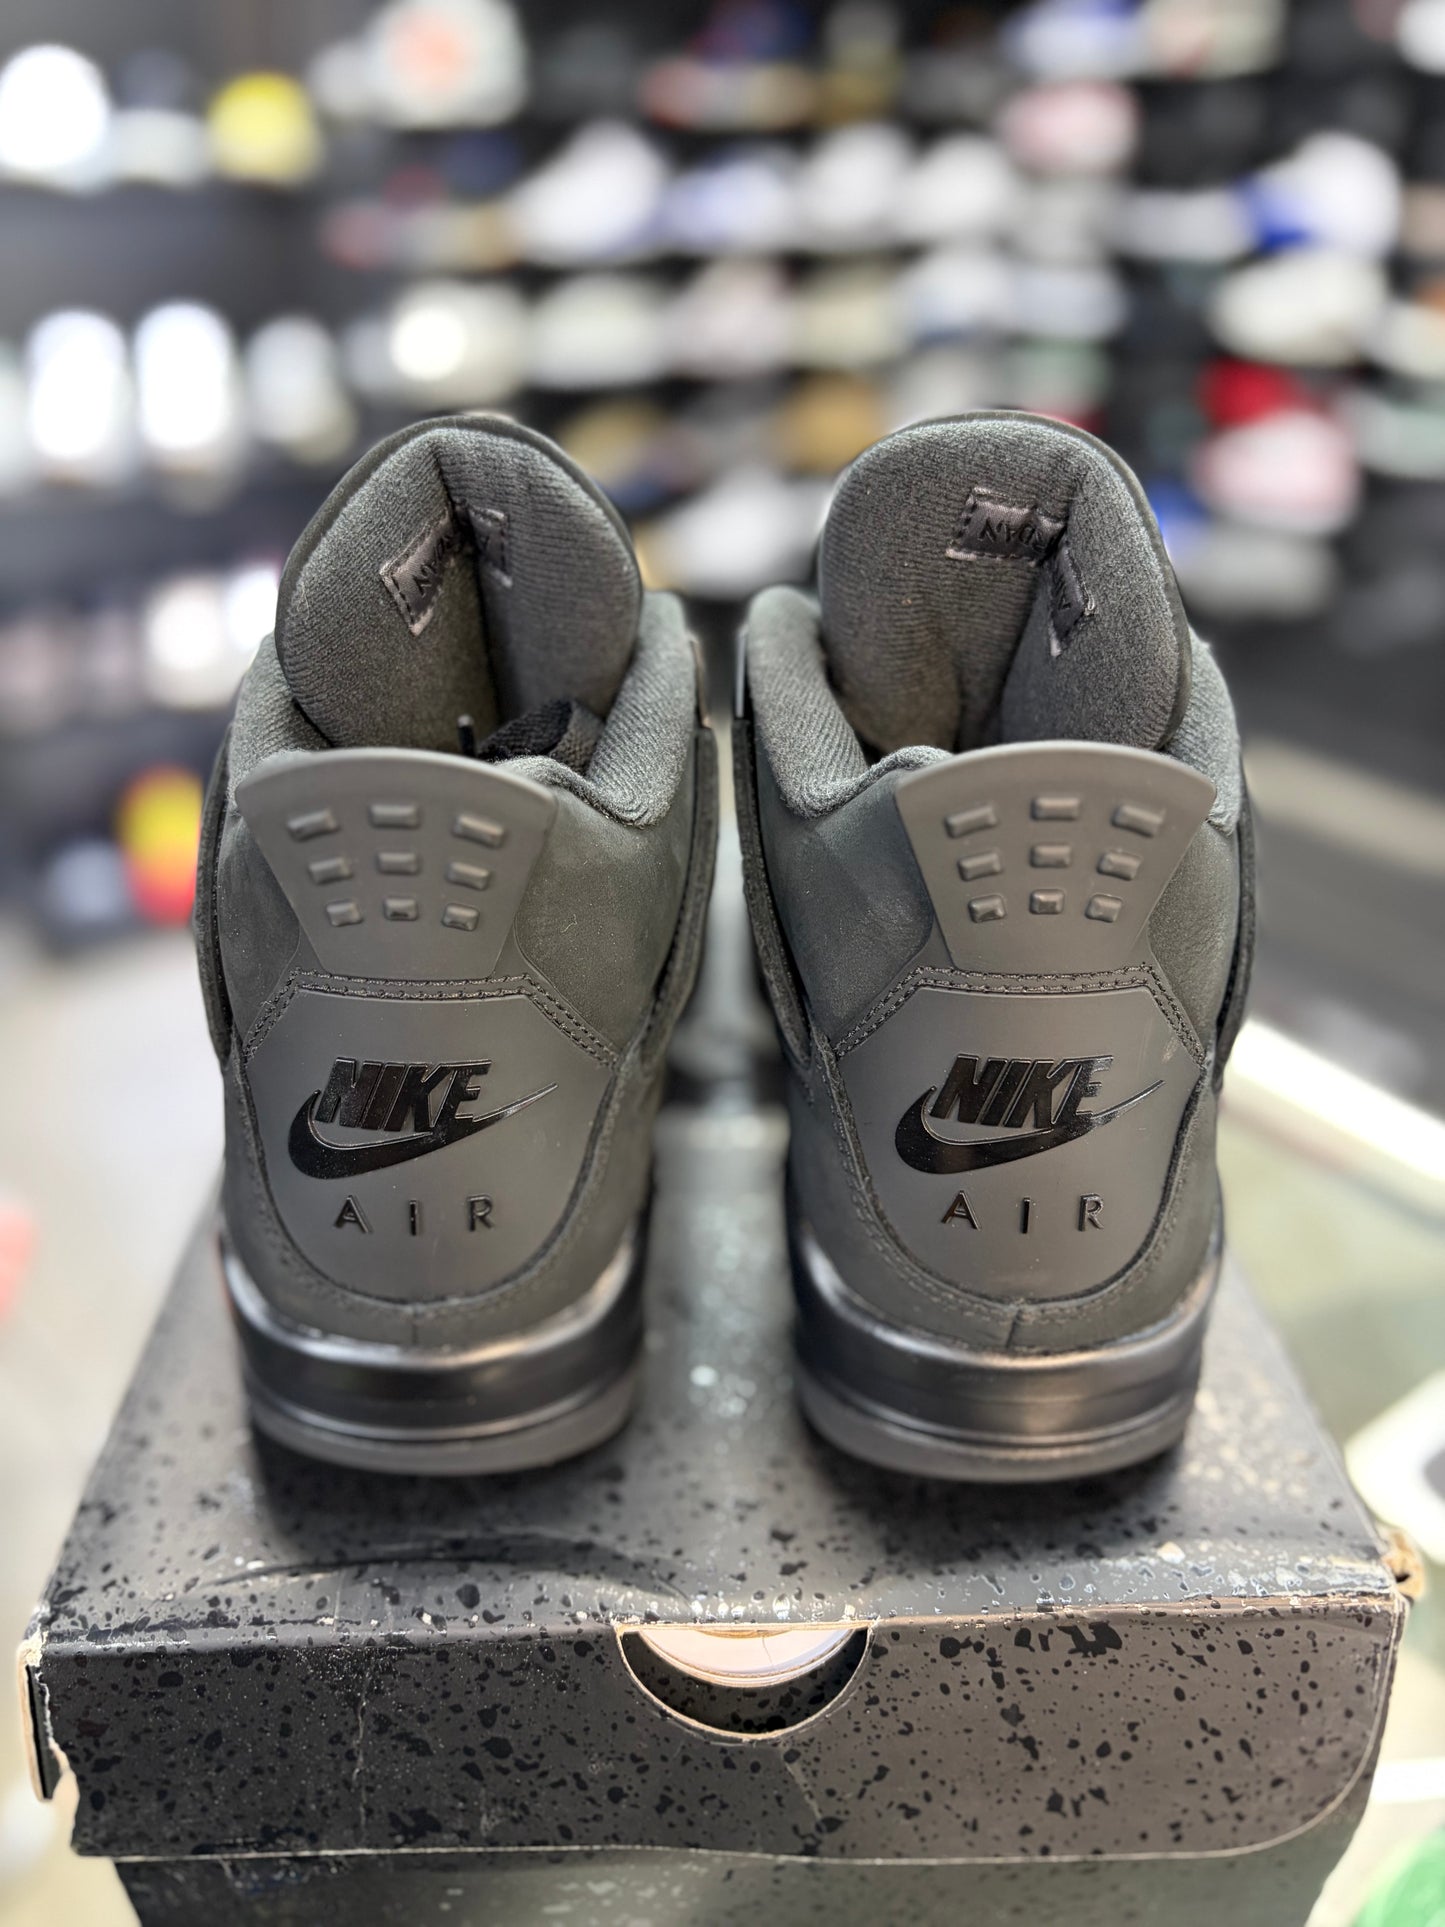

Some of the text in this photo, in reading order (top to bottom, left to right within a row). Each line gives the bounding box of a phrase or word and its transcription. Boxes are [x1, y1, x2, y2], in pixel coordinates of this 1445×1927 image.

[315, 1056, 492, 1132] NIKE
[929, 1053, 1114, 1129] NIKE
[335, 1194, 495, 1236] AIR
[941, 1189, 1105, 1233] AIR
